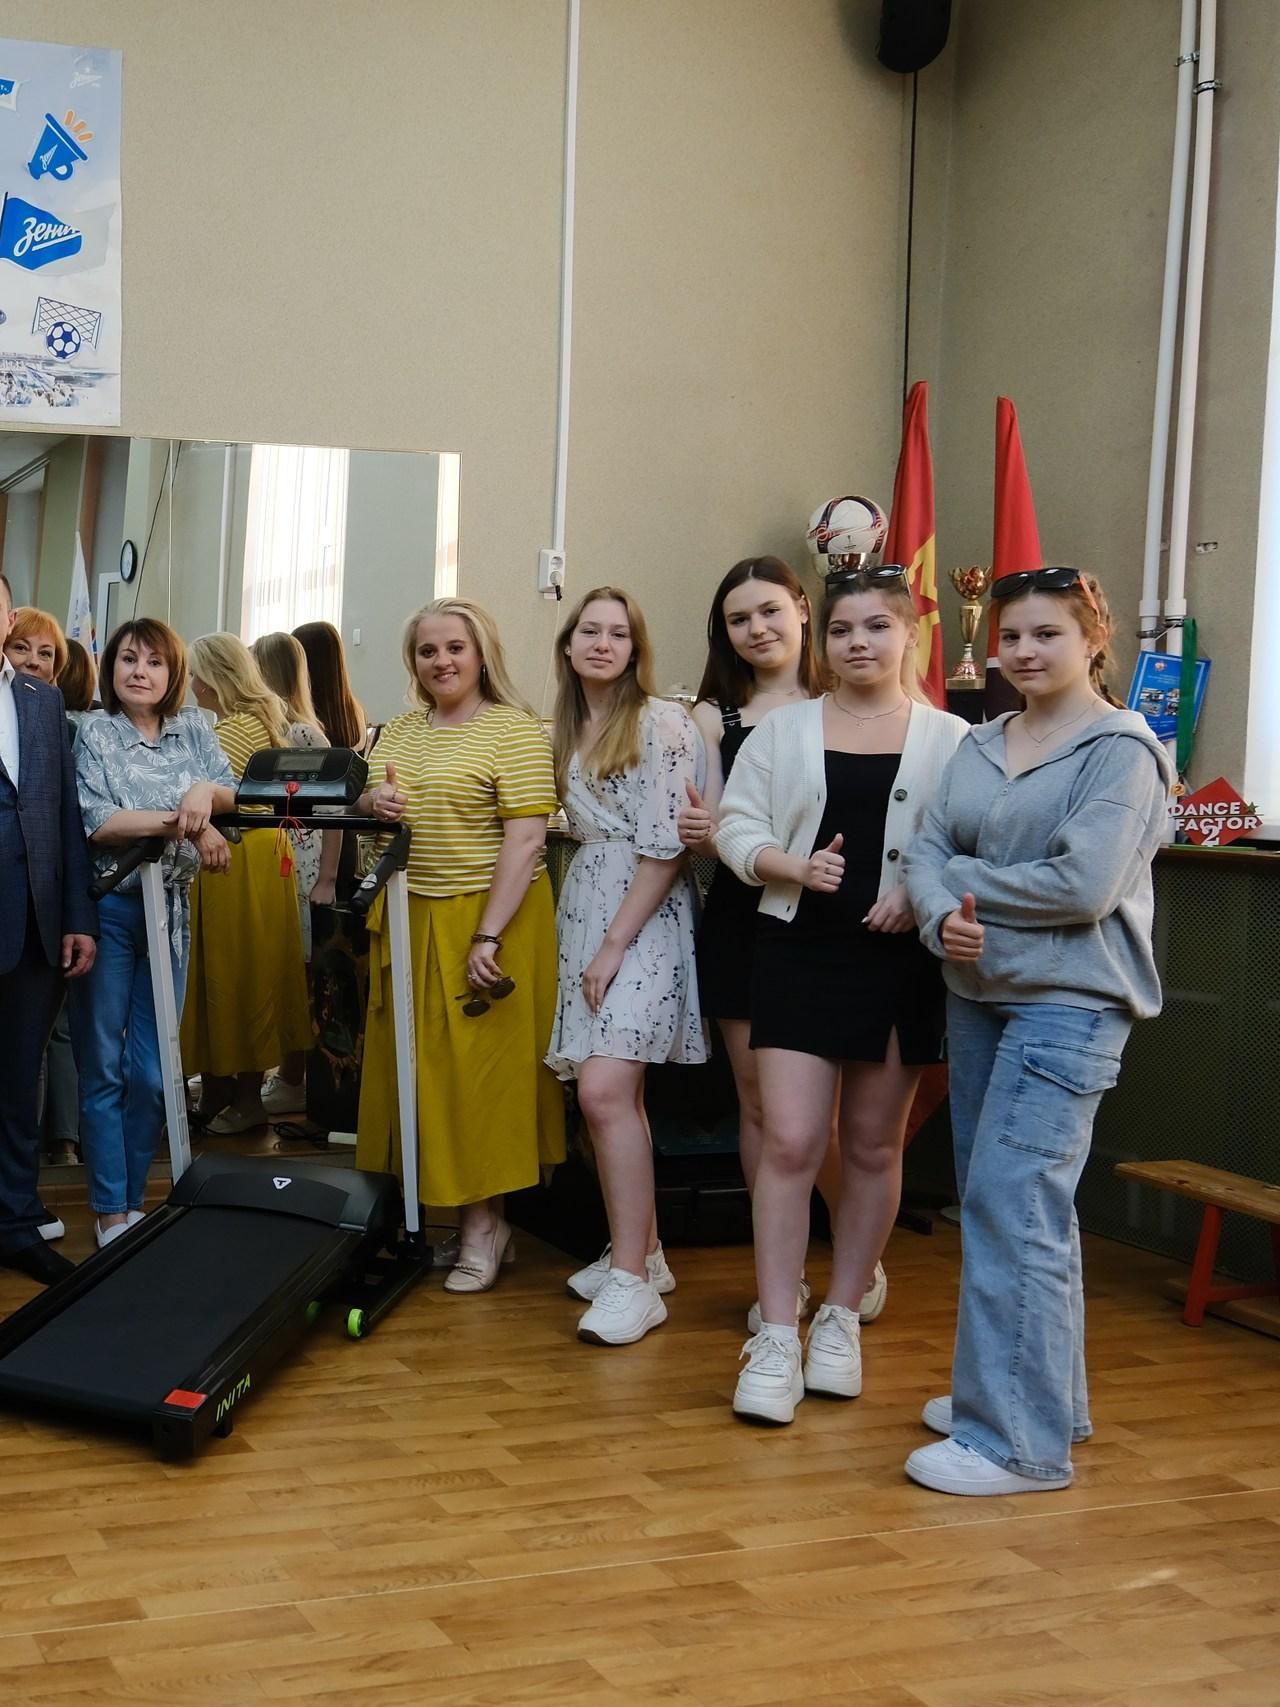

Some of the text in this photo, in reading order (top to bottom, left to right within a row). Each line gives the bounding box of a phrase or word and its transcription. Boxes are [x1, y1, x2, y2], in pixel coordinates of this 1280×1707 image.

[1171, 801, 1241, 816] DANCE
[1175, 816, 1258, 831] FACTOR
[1201, 825, 1220, 847] 2
[215, 1373, 252, 1423] INITA
